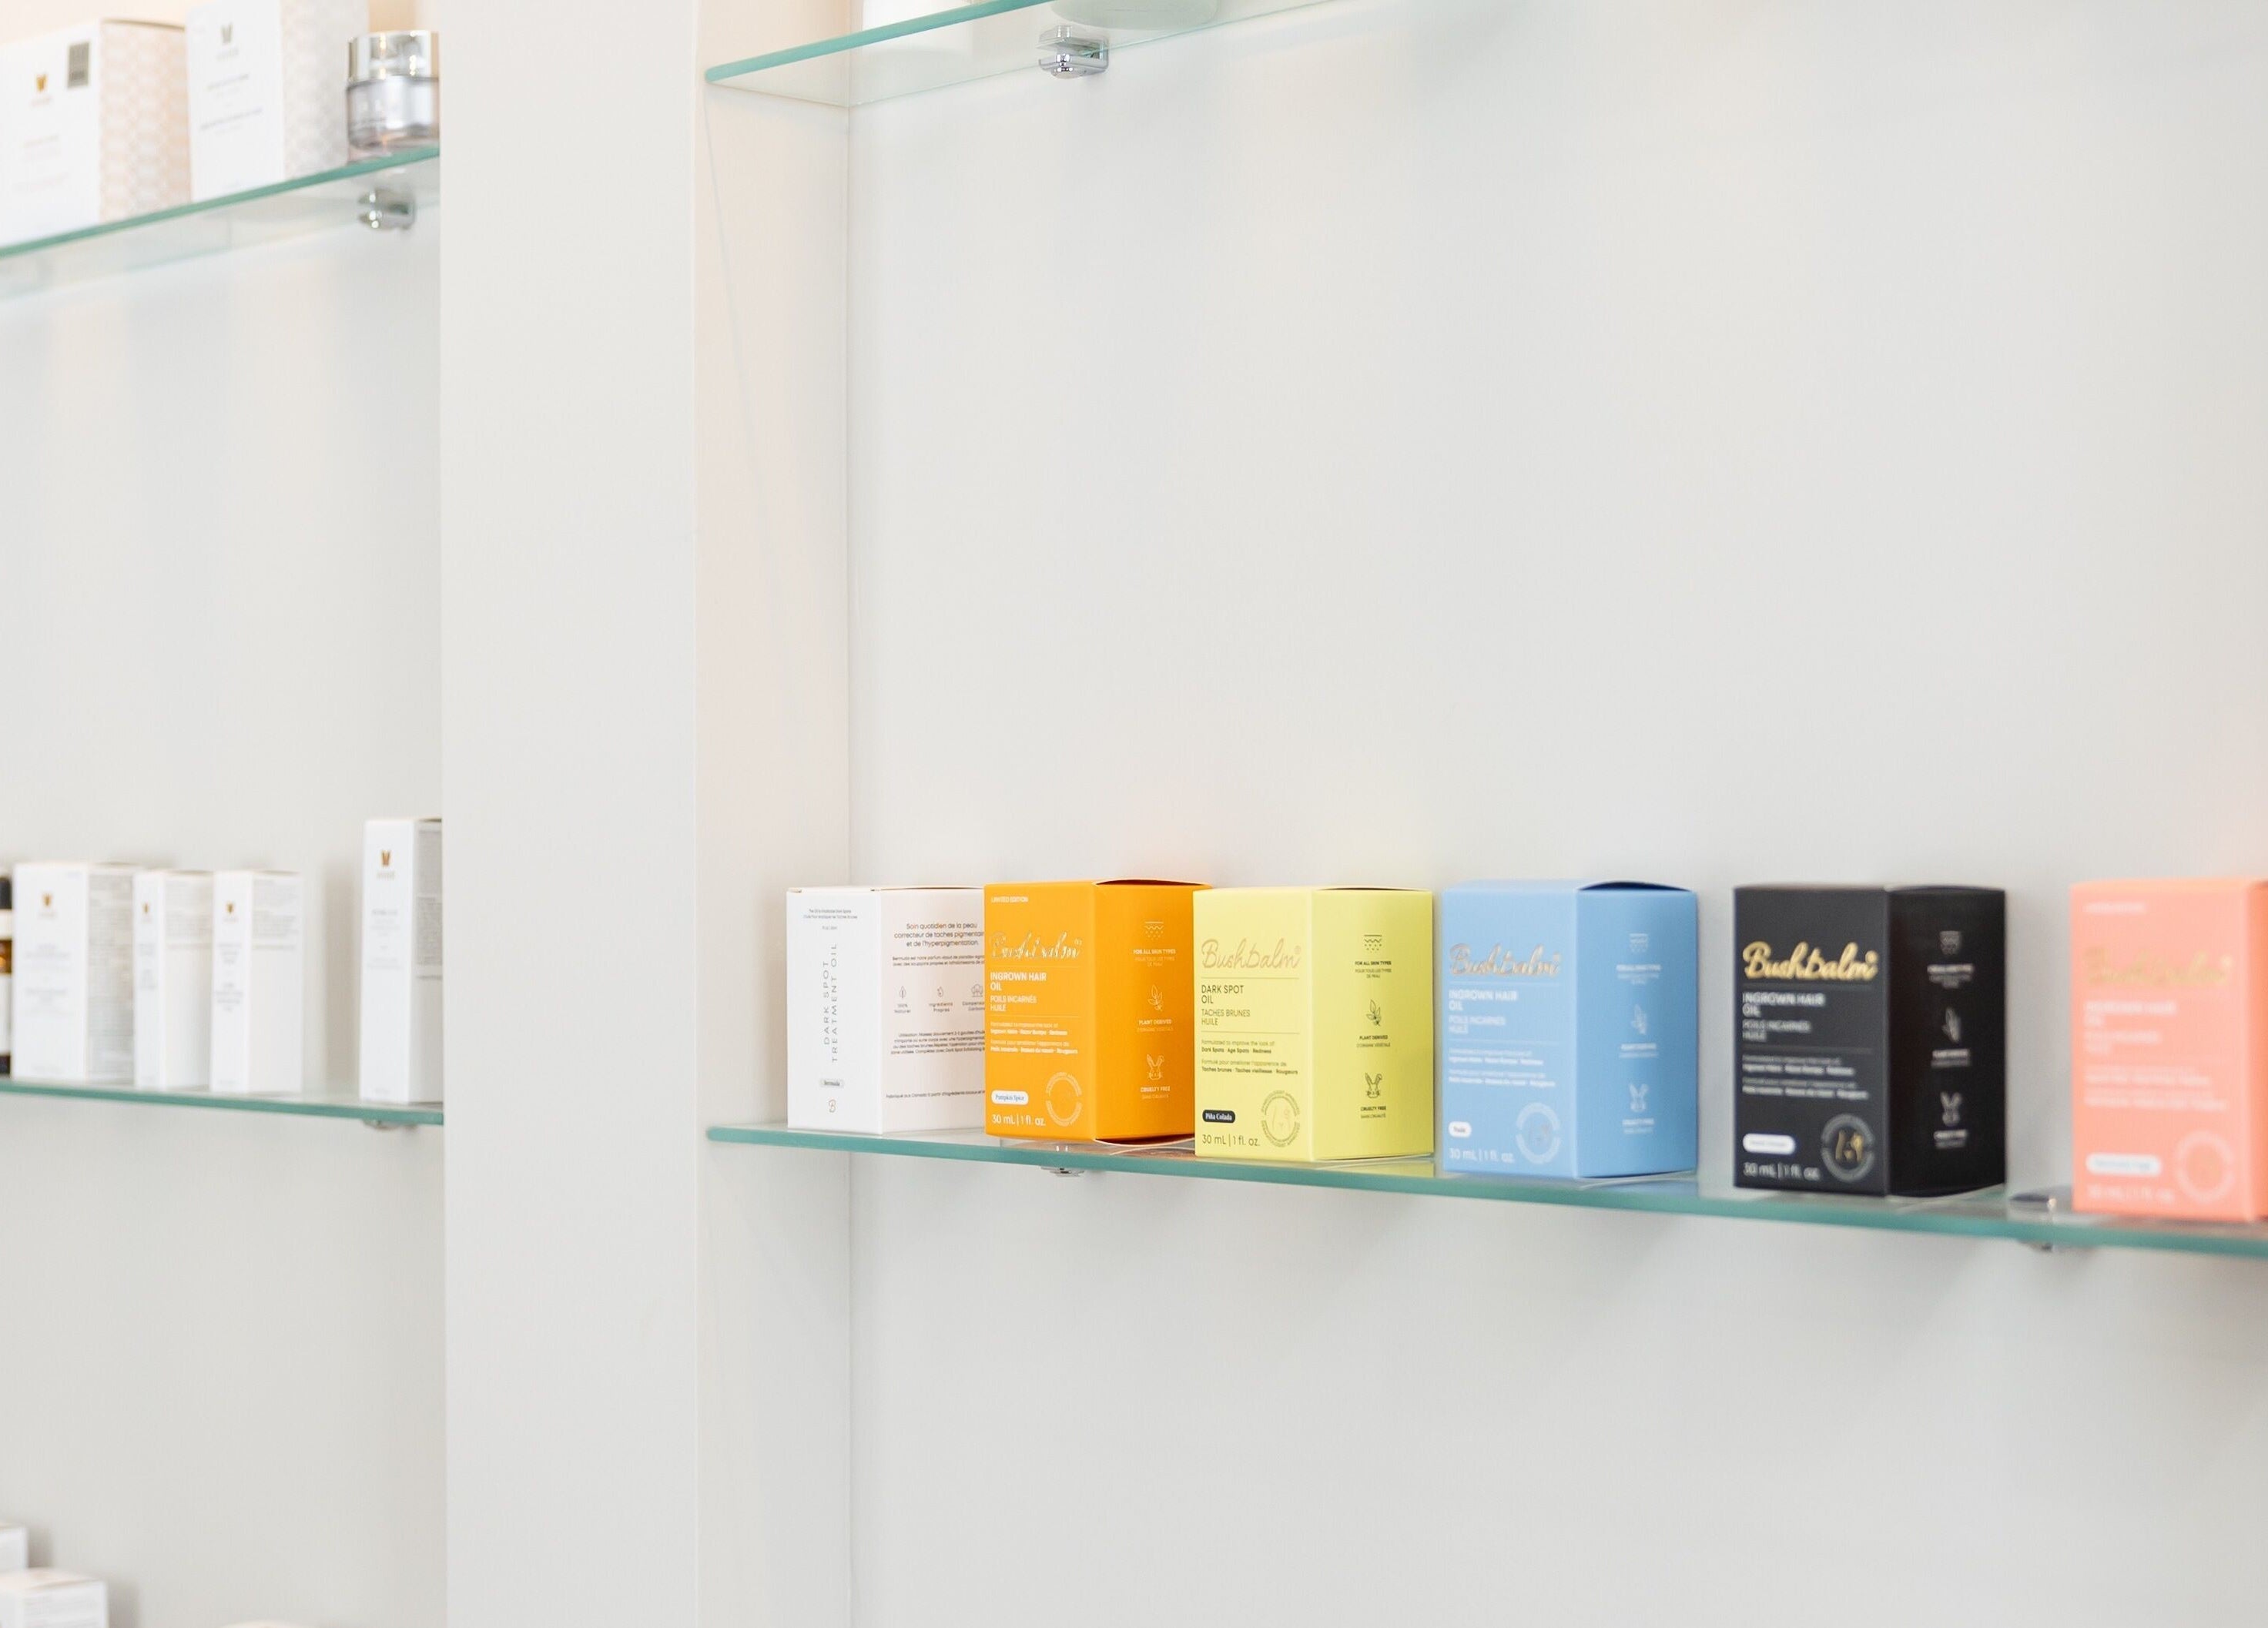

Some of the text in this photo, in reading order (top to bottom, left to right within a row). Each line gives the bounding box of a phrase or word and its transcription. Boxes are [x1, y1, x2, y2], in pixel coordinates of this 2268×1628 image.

[990, 971, 1048, 982] INGROWN HAIR
[990, 982, 1003, 992] OIL
[1201, 984, 1245, 994] DARK SPOT
[1201, 994, 1214, 1004] OIL
[1742, 991, 1826, 1007] INGROWN HAIR
[1201, 1008, 1251, 1017] TACHES BRUNES
[1201, 1017, 1219, 1026] HUILE
[992, 1114, 1002, 1124] 30
[1003, 1114, 1015, 1125] mL
[1216, 1113, 1233, 1121] Colada
[1201, 1134, 1213, 1144] 30
[1214, 1134, 1227, 1146] mL
